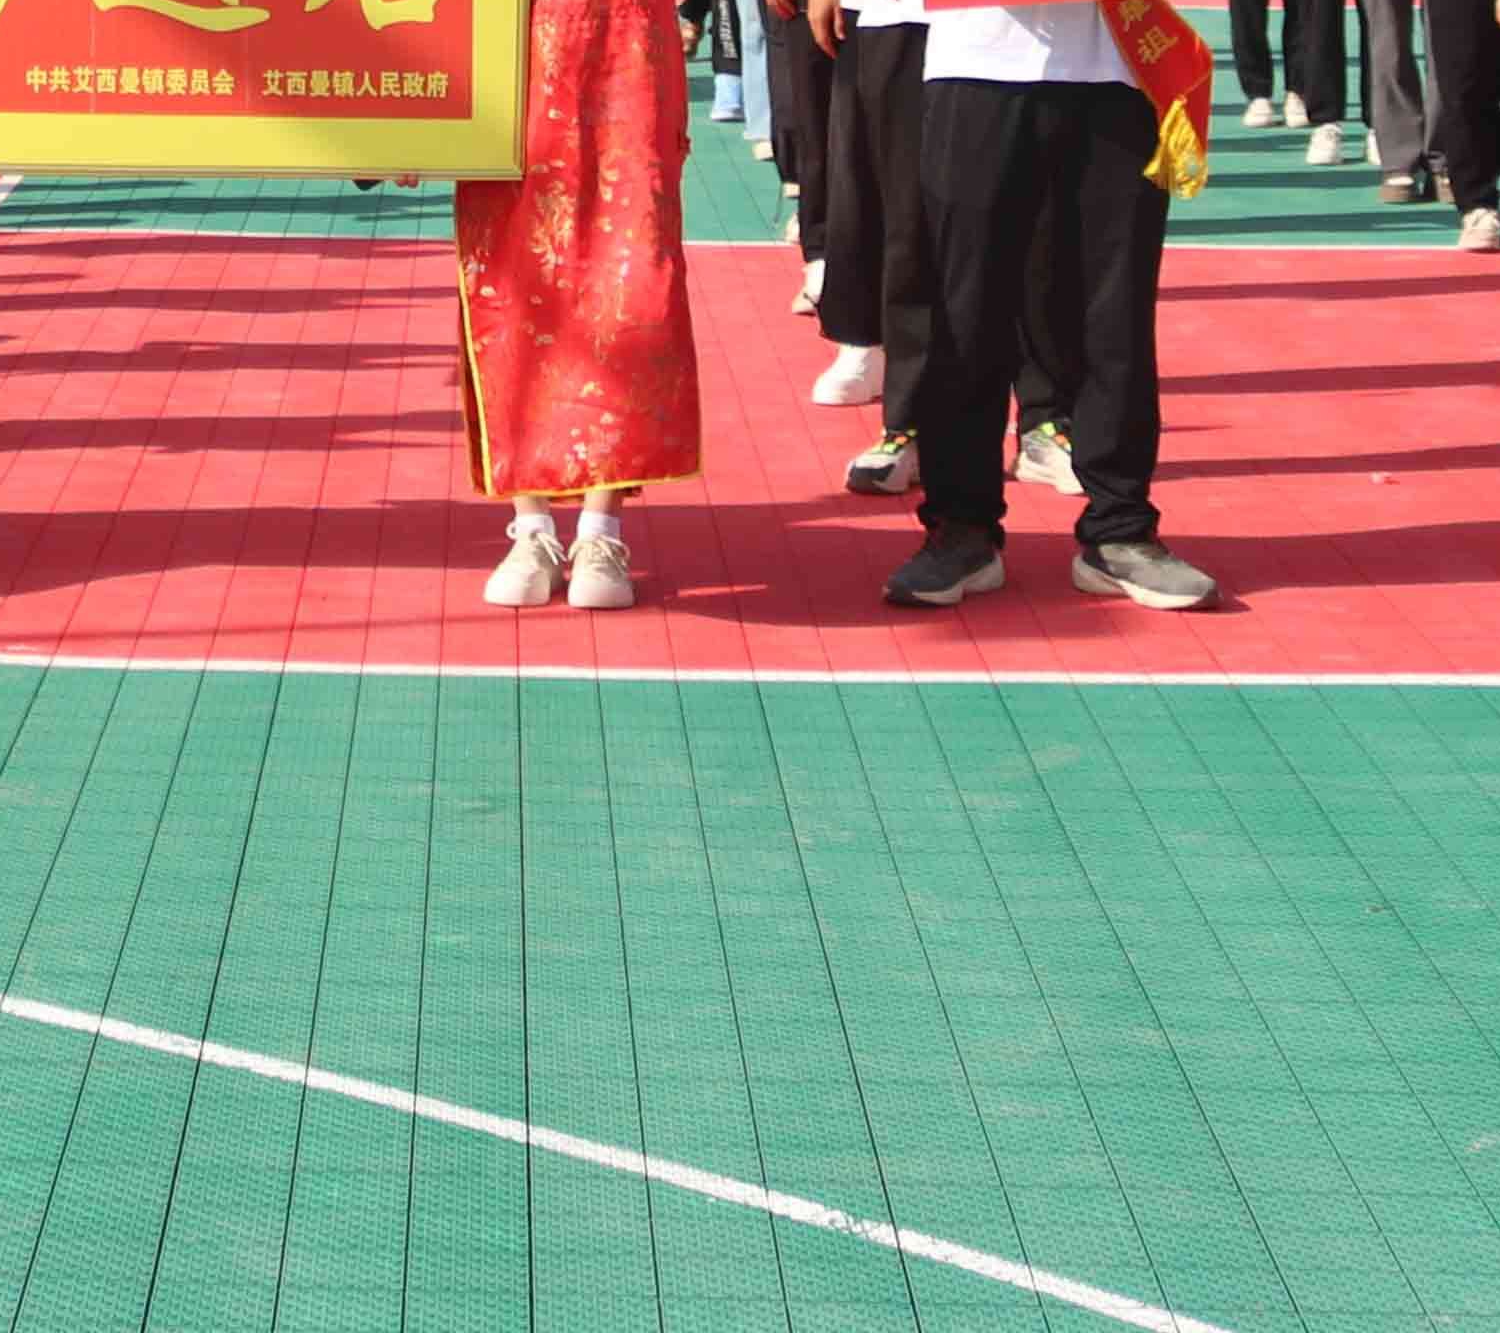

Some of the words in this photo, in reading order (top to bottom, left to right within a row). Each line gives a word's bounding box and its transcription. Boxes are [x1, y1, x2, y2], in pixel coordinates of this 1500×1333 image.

[26, 65, 235, 96] 中共艾西曼镇委员会
[262, 68, 451, 99] 艾西曼镇人民政府
